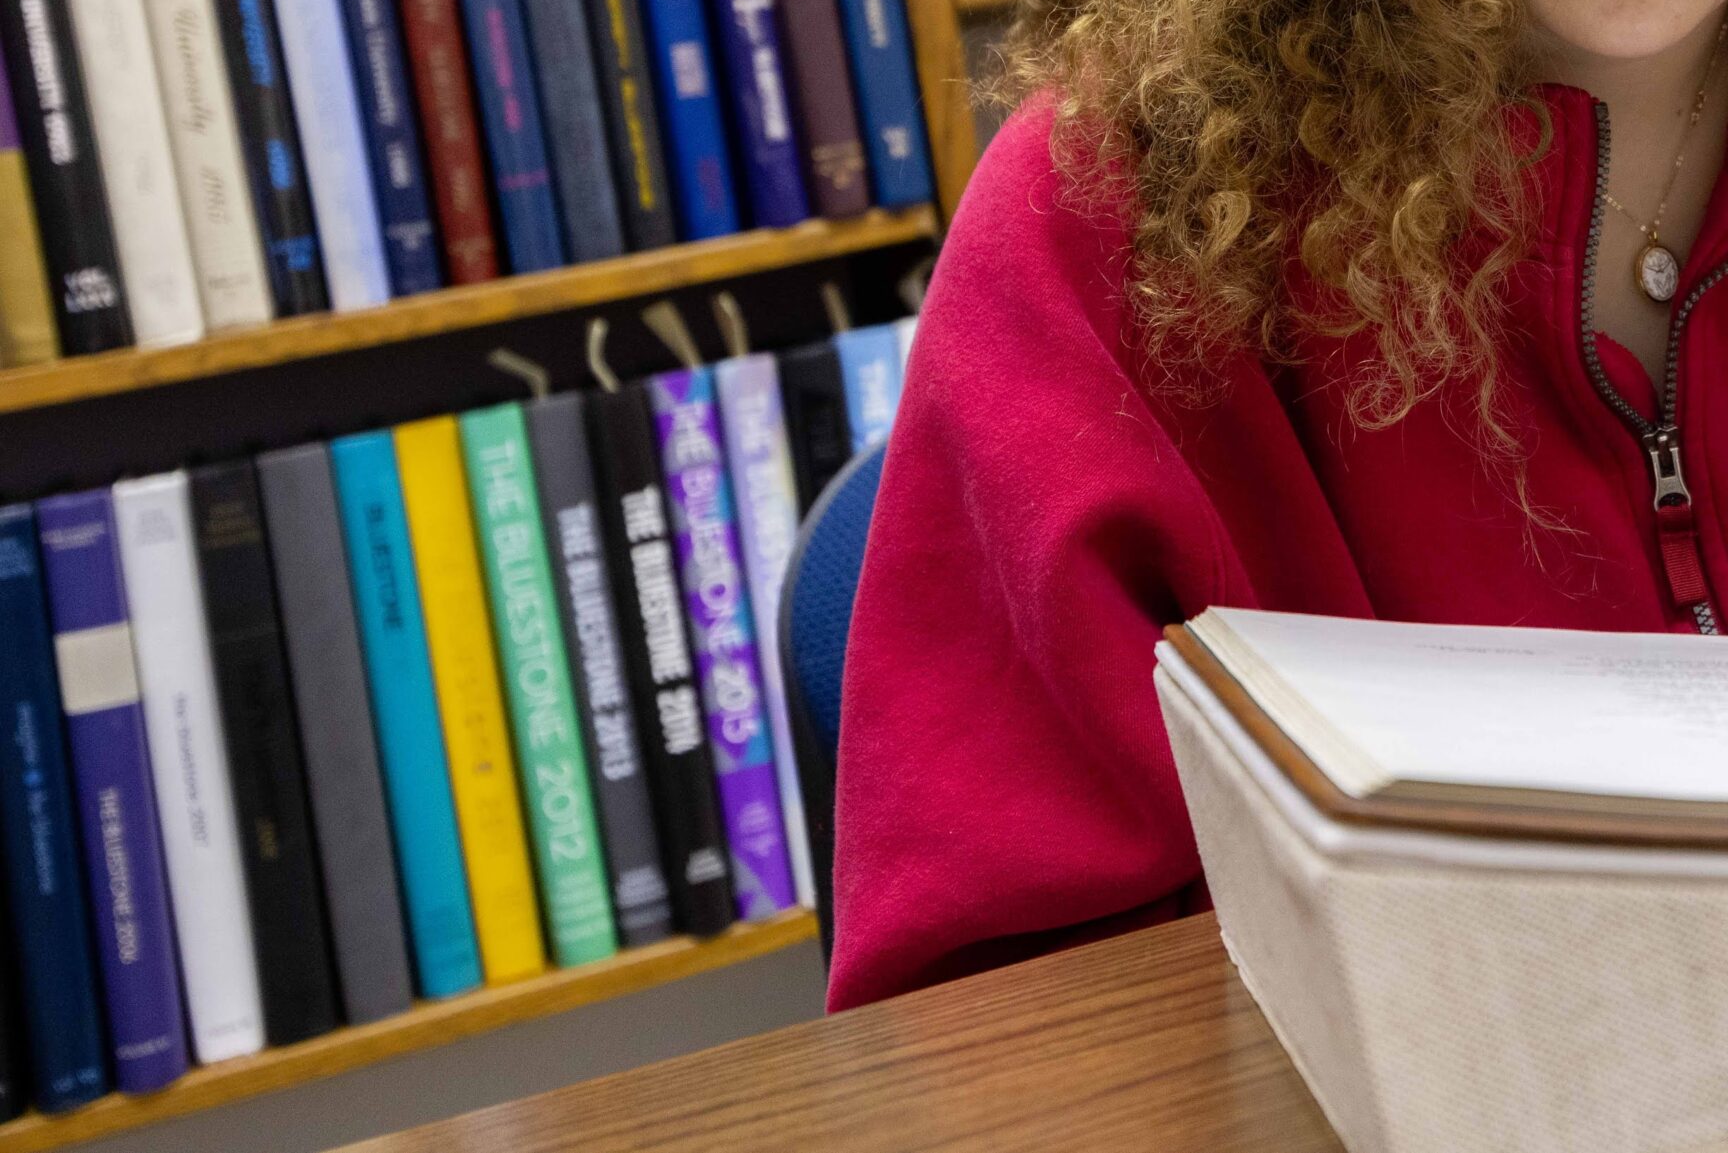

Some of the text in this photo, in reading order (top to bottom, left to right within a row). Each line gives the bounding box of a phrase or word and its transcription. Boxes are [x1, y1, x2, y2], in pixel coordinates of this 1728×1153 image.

[165, 5, 216, 138] University
[736, 392, 772, 455] THE
[856, 359, 891, 423] THE
[363, 501, 403, 633] BLUESTONE
[620, 484, 703, 757] THE BLUESTONE 2014
[669, 400, 760, 748] THE BLUESTONE 2015
[476, 439, 589, 865] THE BLUESTONE 2012
[557, 502, 635, 782] THE BLUESTONE 2013
[97, 787, 120, 818] THE
[176, 724, 202, 801] bluestone
[101, 820, 135, 917] BLUESTONE
